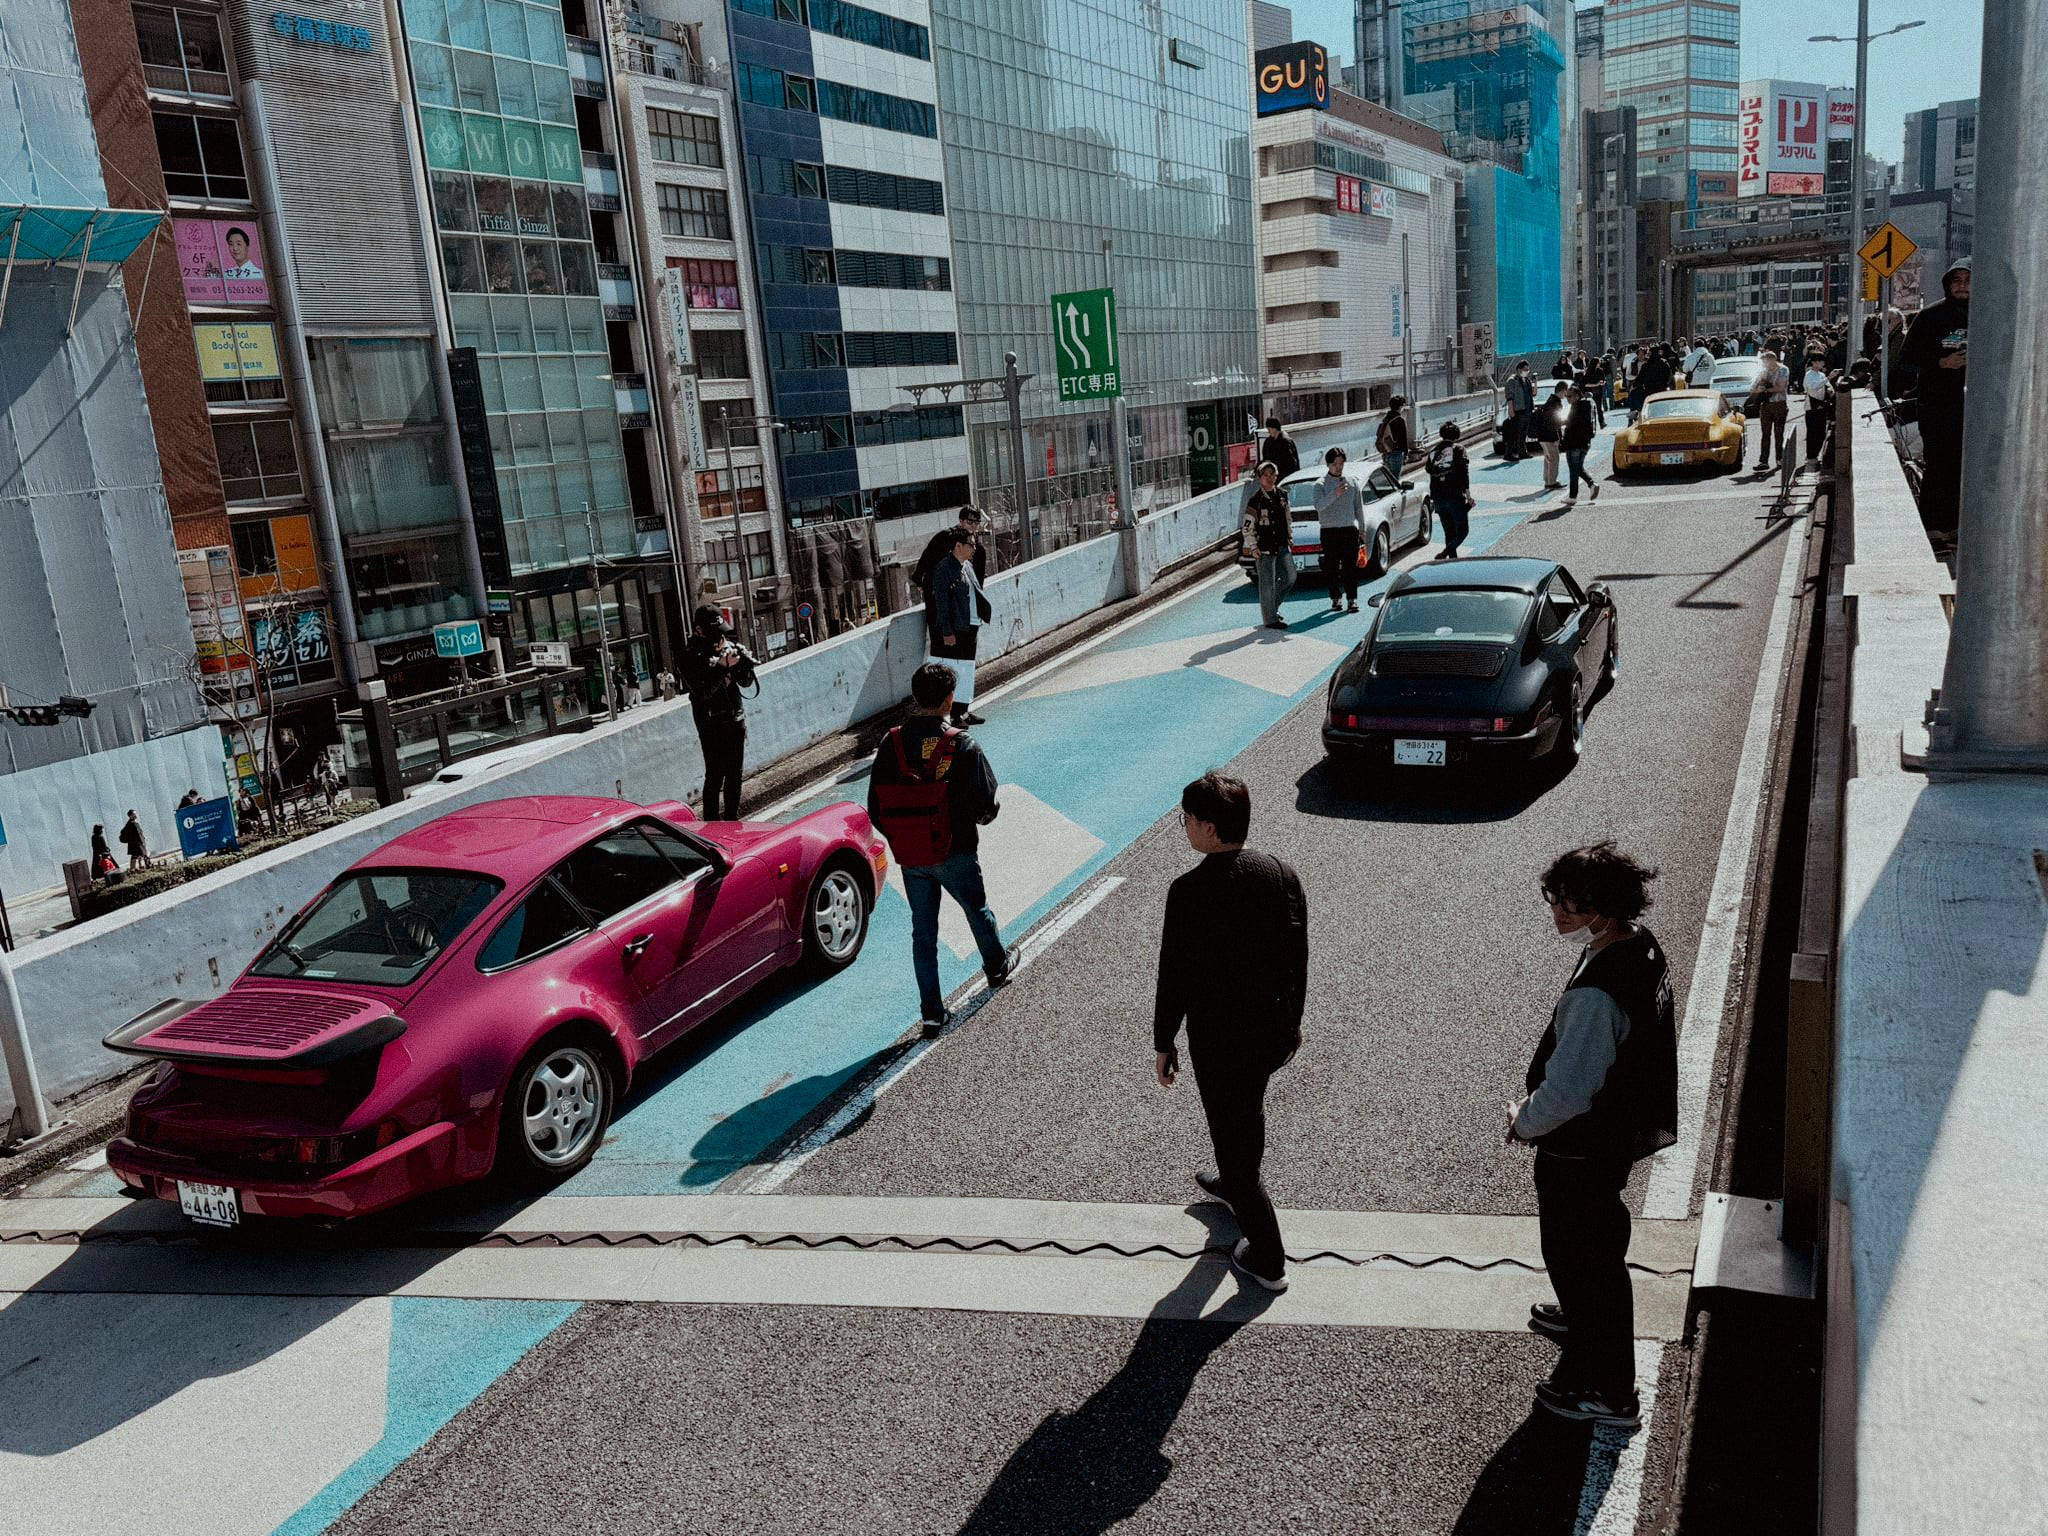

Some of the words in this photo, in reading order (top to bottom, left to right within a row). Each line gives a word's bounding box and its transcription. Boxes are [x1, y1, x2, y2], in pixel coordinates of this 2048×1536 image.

[1259, 59, 1306, 94] GU
[469, 131, 573, 171] WOM
[1741, 112, 1763, 181] プリマハム
[1777, 145, 1817, 160] プリマハム
[480, 214, 512, 231] Tiffa
[517, 216, 550, 233] Ginza
[192, 252, 206, 264] 6F
[221, 330, 249, 340] Total
[211, 341, 234, 351] Body
[239, 340, 258, 350] Care
[1061, 372, 1116, 396] ETC専用
[406, 647, 436, 662] GINZA
[1426, 750, 1443, 764] 22
[193, 1195, 237, 1222] 44-08
